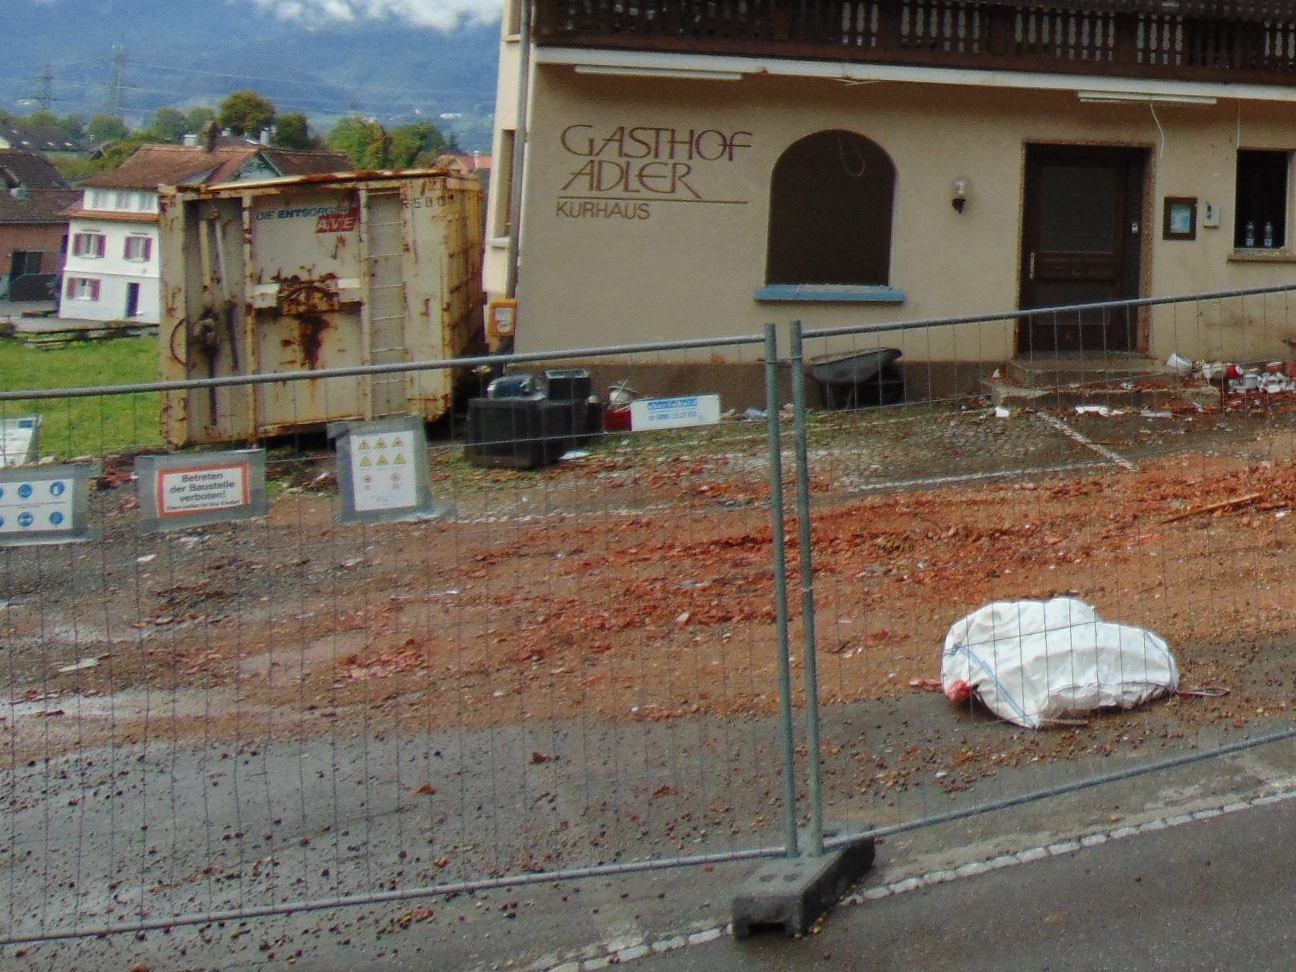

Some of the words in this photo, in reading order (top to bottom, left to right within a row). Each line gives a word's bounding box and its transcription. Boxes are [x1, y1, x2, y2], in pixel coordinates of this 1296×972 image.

[561, 124, 753, 162] GASTHOF
[561, 159, 704, 200] ADLER
[555, 201, 651, 220] KURHAUS
[181, 472, 224, 483] Betreten
[169, 485, 186, 494] der
